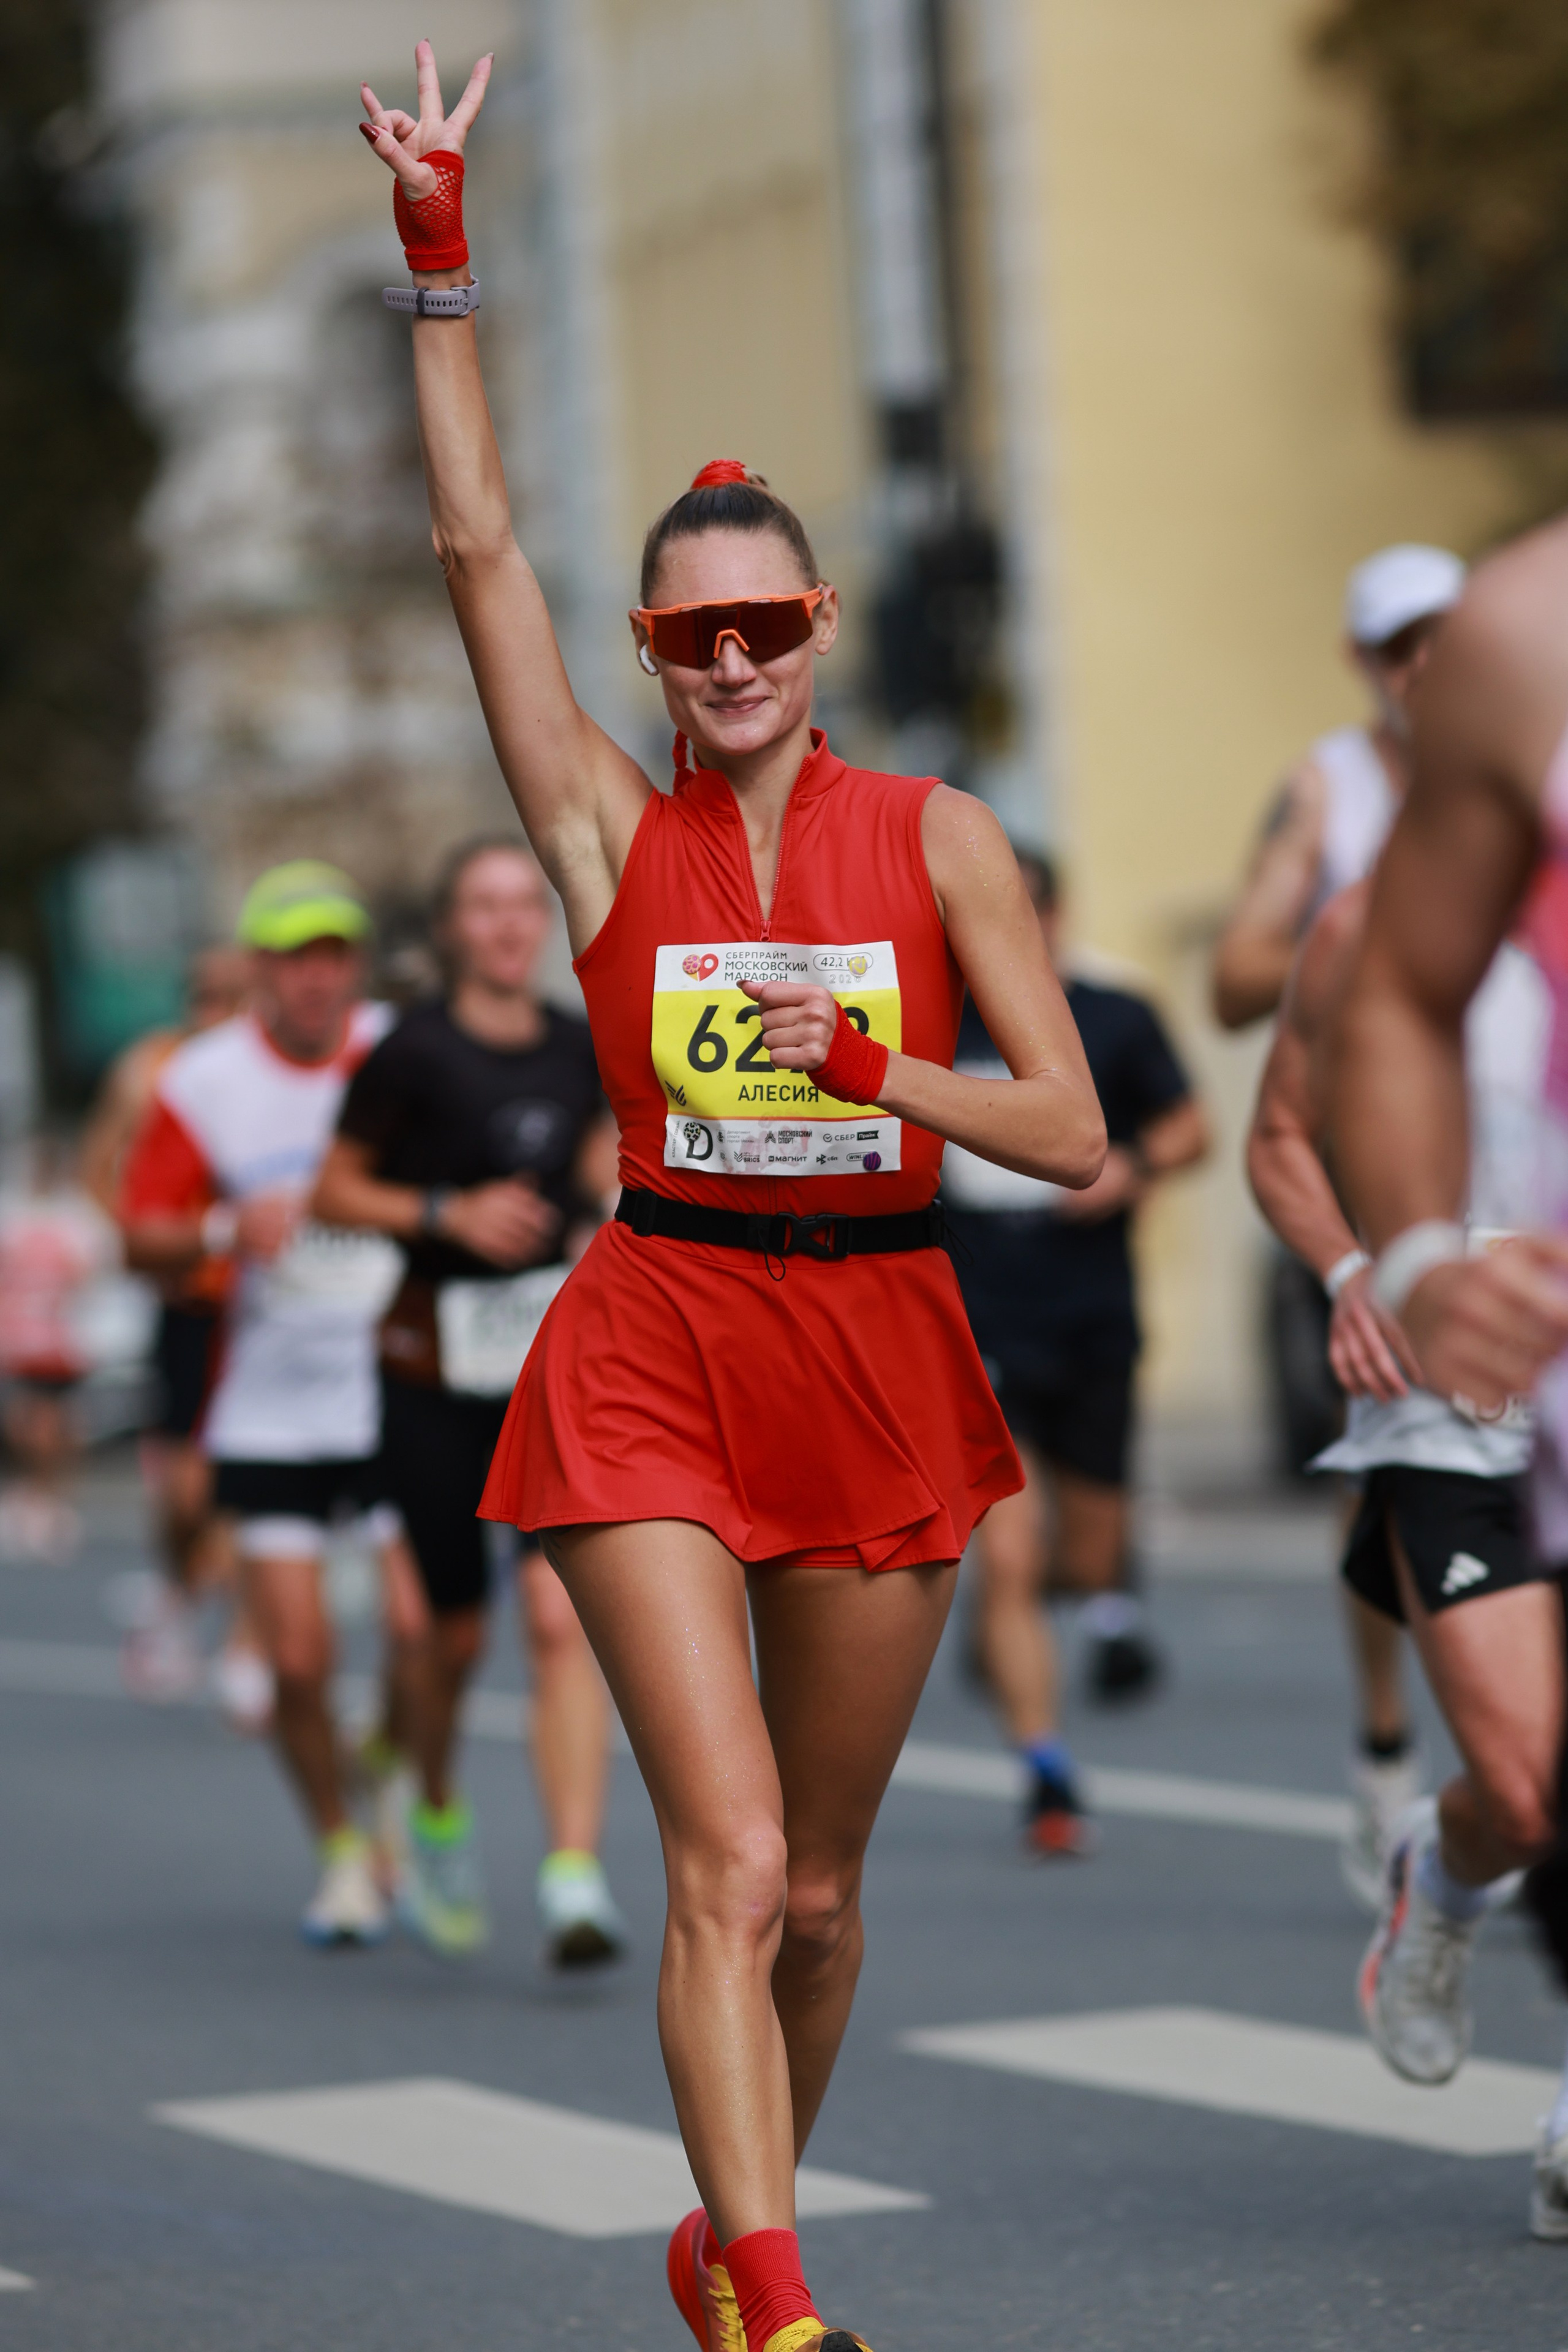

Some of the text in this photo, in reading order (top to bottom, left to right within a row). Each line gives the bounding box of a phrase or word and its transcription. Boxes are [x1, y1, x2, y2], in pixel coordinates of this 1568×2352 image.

[726, 951, 787, 959] СБЕРПРАЙМ
[725, 961, 808, 972] МОСКОВСКИЙ
[821, 957, 843, 967] 42,2
[725, 972, 788, 982] МАРАФОН
[687, 1005, 869, 1073] 62
[738, 1084, 819, 1102] АЛЕСИЯ
